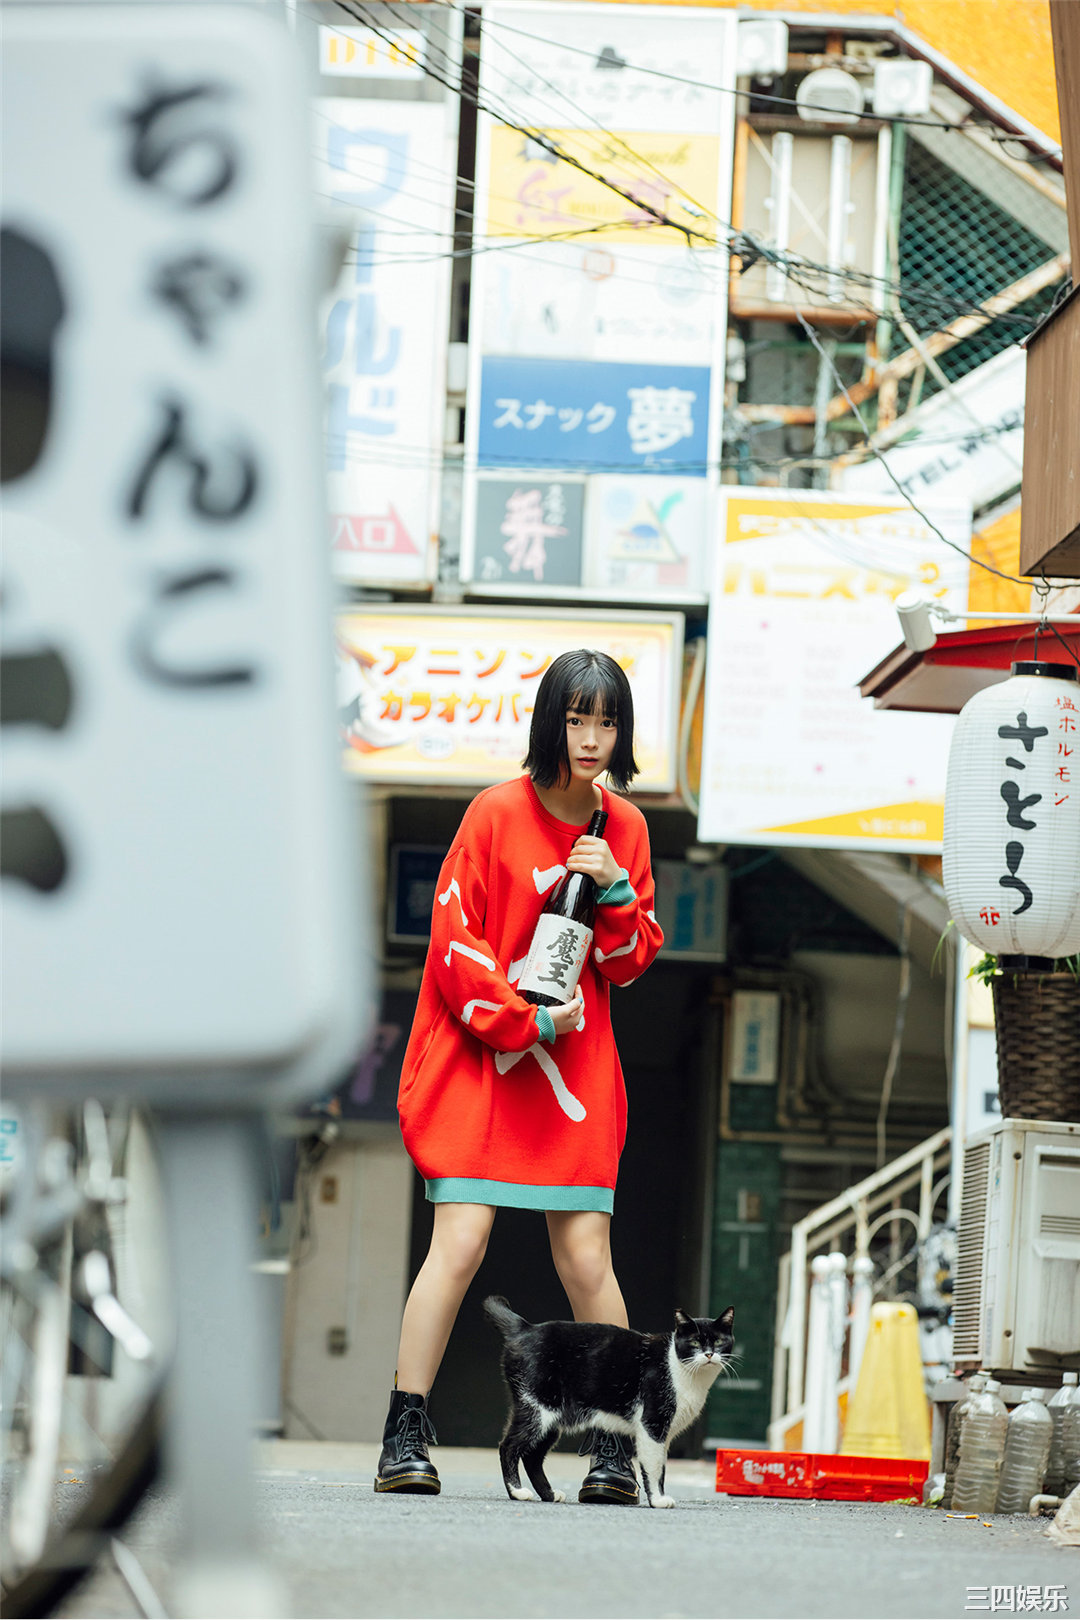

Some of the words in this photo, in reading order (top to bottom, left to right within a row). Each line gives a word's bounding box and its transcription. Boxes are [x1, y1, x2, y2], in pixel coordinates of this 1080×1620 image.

[114, 74, 258, 691] ちゃんこ
[493, 398, 617, 434] スナック
[627, 386, 697, 454] 夢
[381, 645, 552, 680] アニソン
[998, 711, 1048, 914] さとう
[536, 927, 579, 989] 魔王
